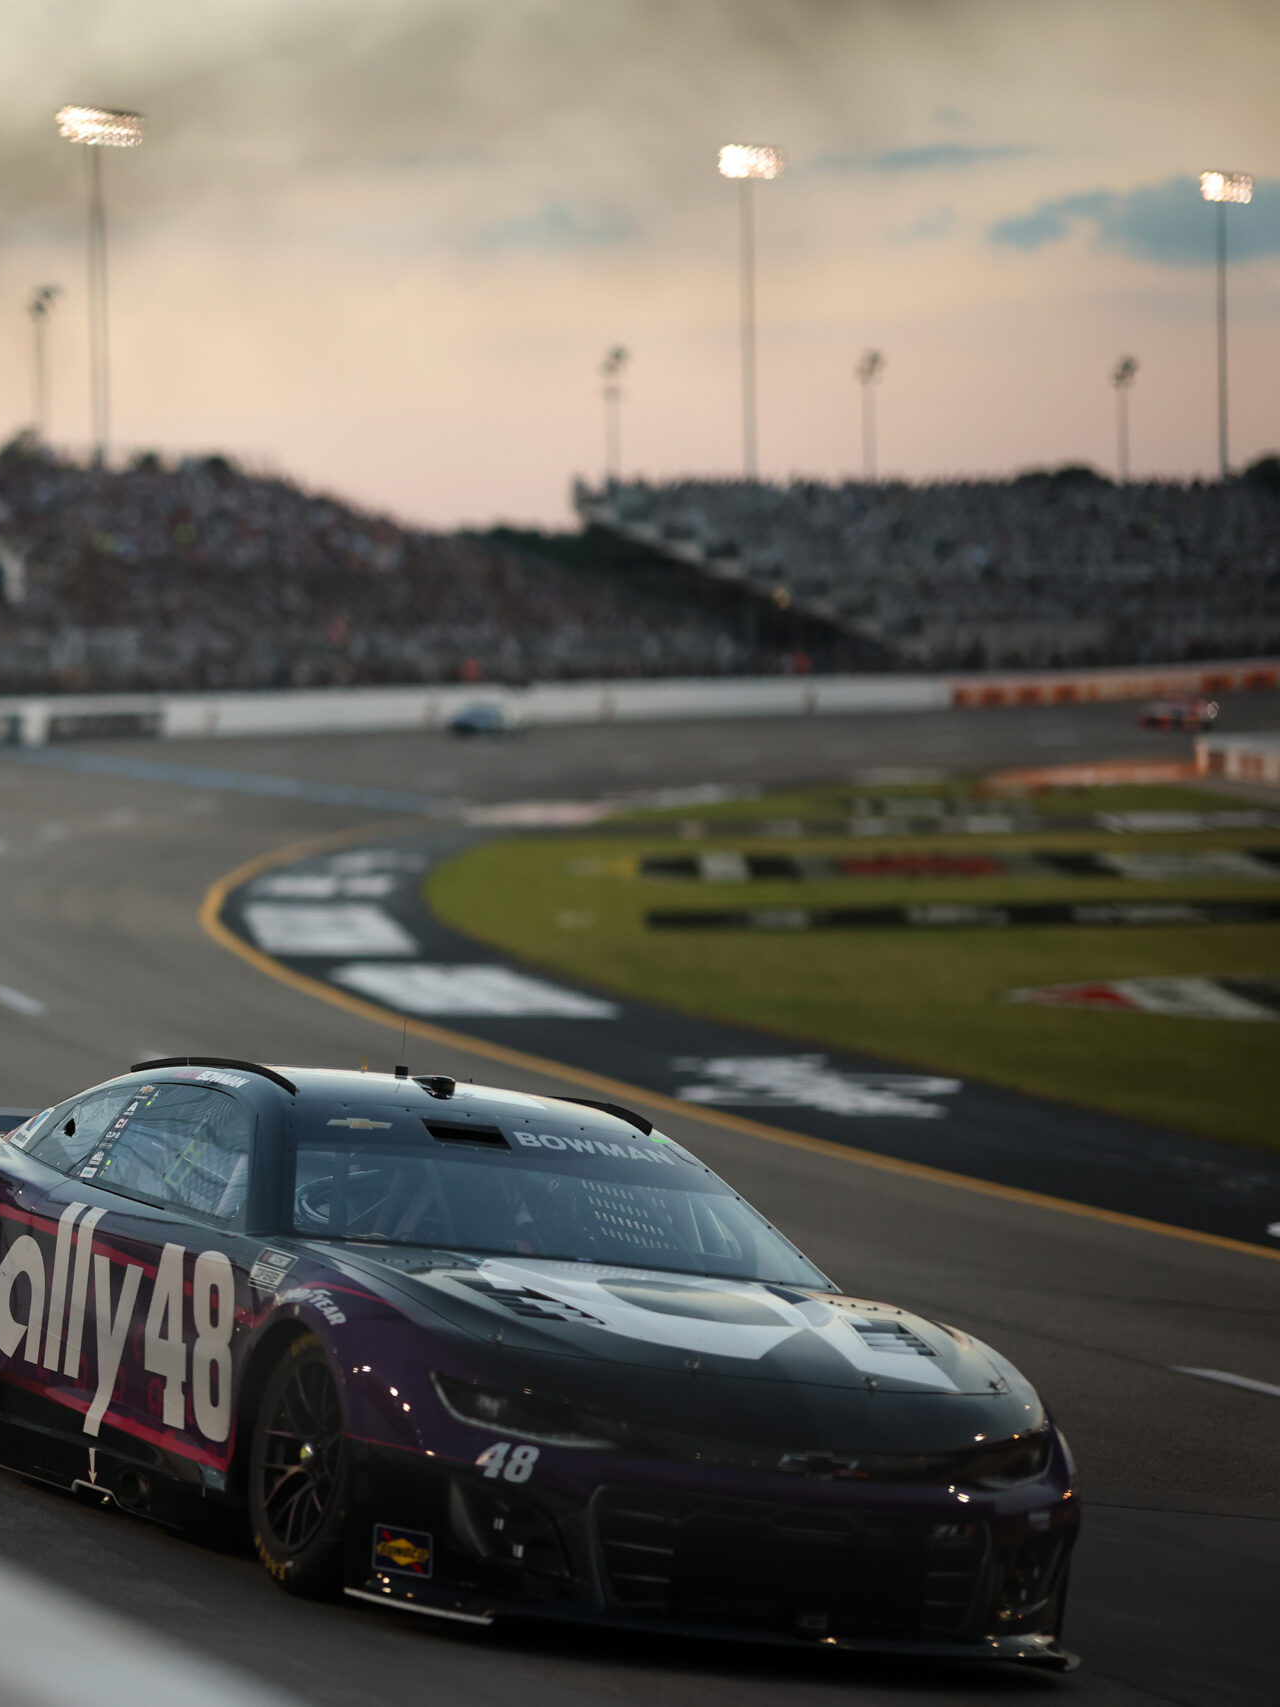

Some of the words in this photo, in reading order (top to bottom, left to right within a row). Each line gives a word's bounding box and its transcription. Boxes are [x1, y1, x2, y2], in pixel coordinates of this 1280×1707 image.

[194, 1070, 251, 1088] BOWMAN
[513, 1130, 676, 1166] BOWMAN
[144, 1242, 236, 1443] 48
[475, 1441, 540, 1483] 48
